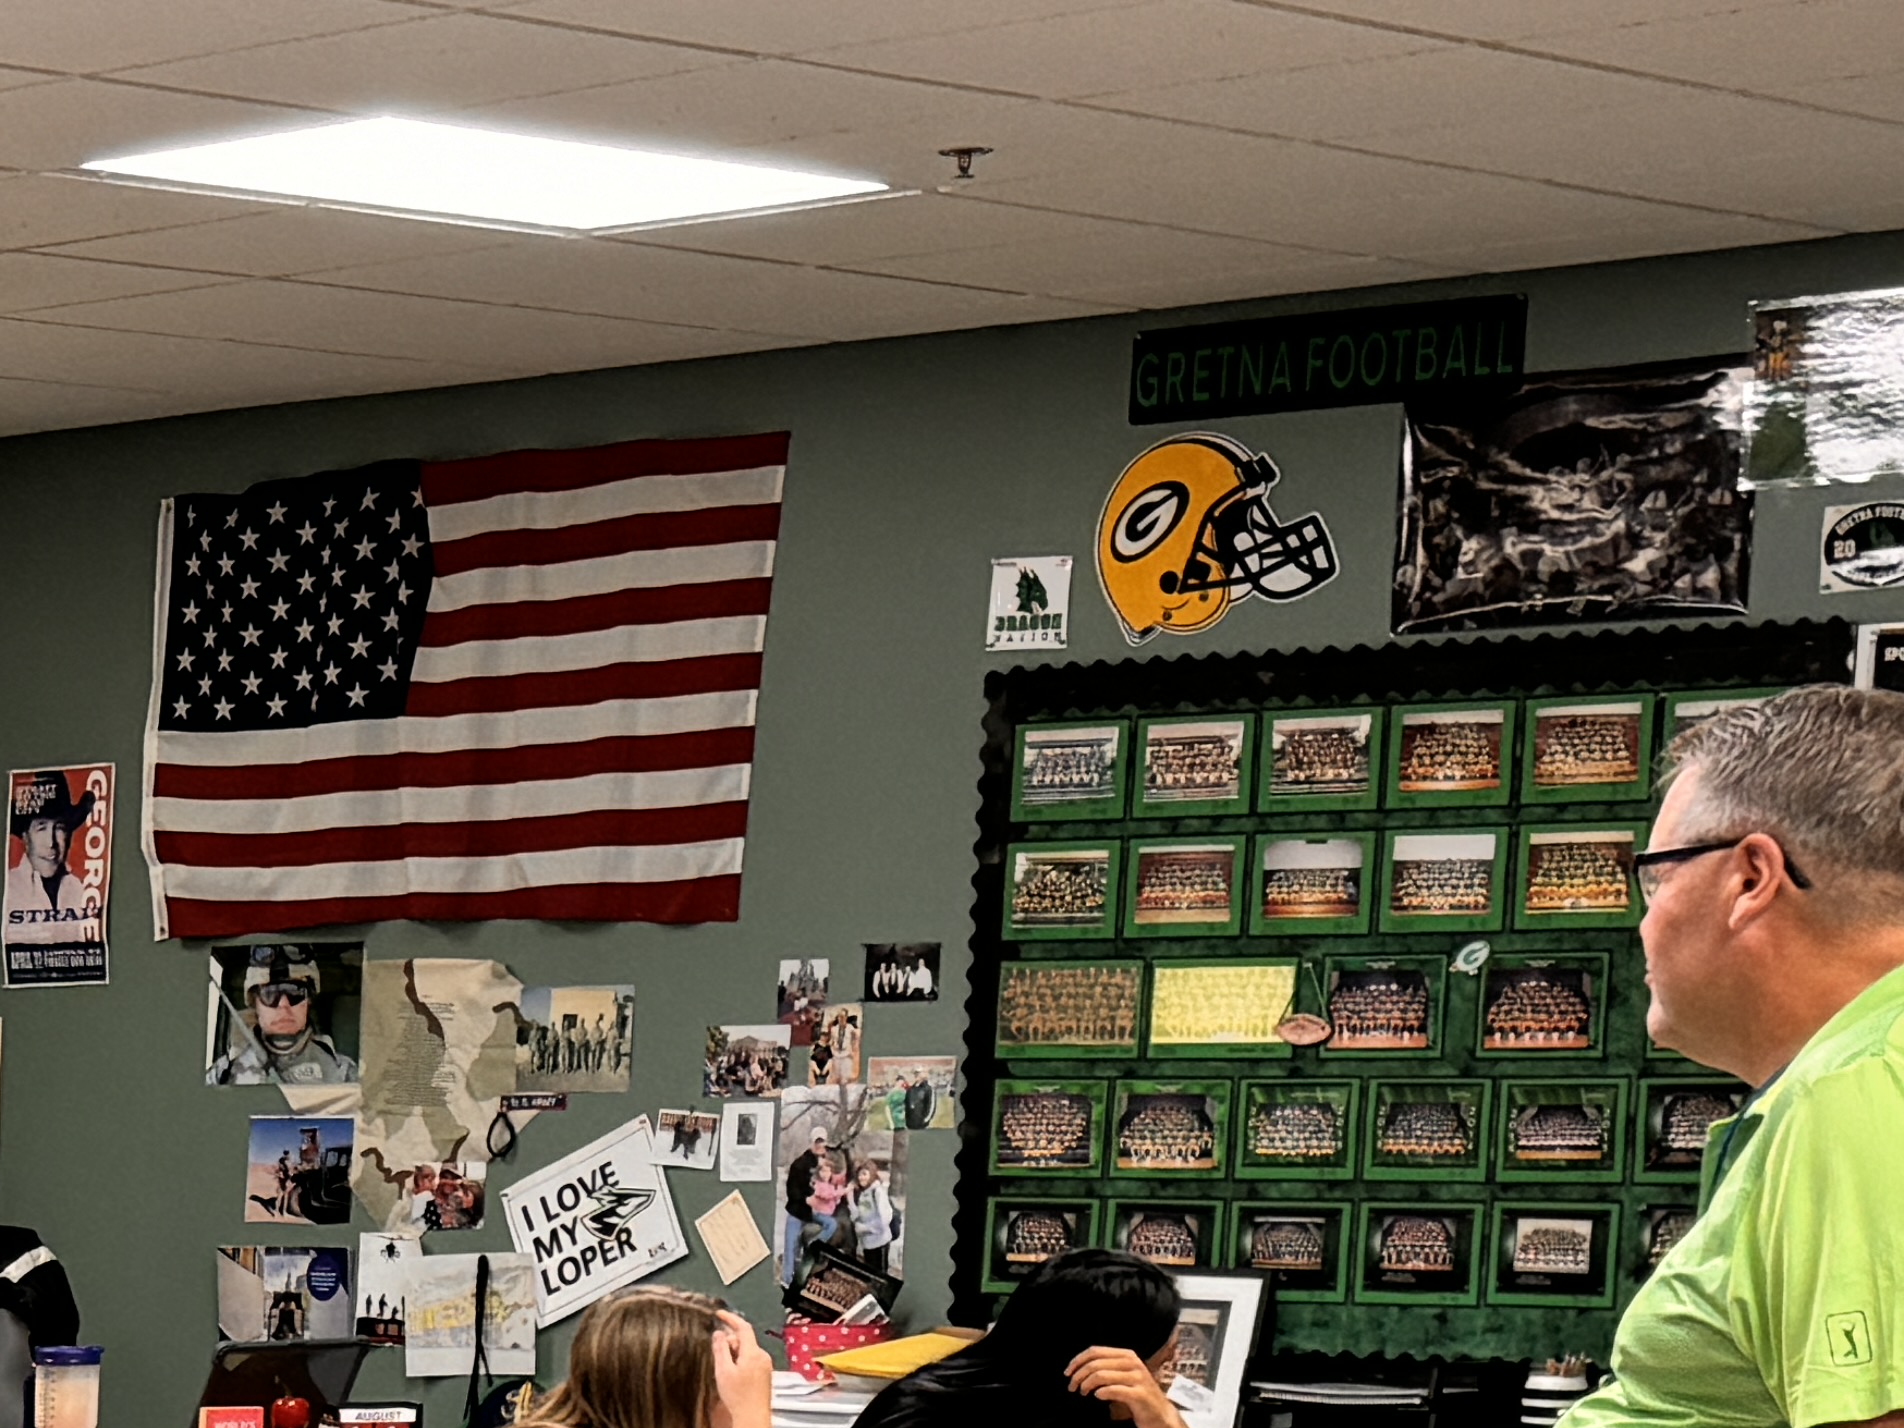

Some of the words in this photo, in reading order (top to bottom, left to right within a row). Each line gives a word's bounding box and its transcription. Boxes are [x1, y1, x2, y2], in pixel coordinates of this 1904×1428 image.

[1136, 343, 1291, 408] GRETNA
[1305, 321, 1513, 391] FOOTBALL
[80, 770, 108, 943] GEORGE
[521, 1205, 535, 1232] I
[539, 1161, 620, 1223] LOVE
[533, 1215, 580, 1264] MY
[541, 1226, 638, 1297] LOPER
[354, 1410, 402, 1422] AUGUST
